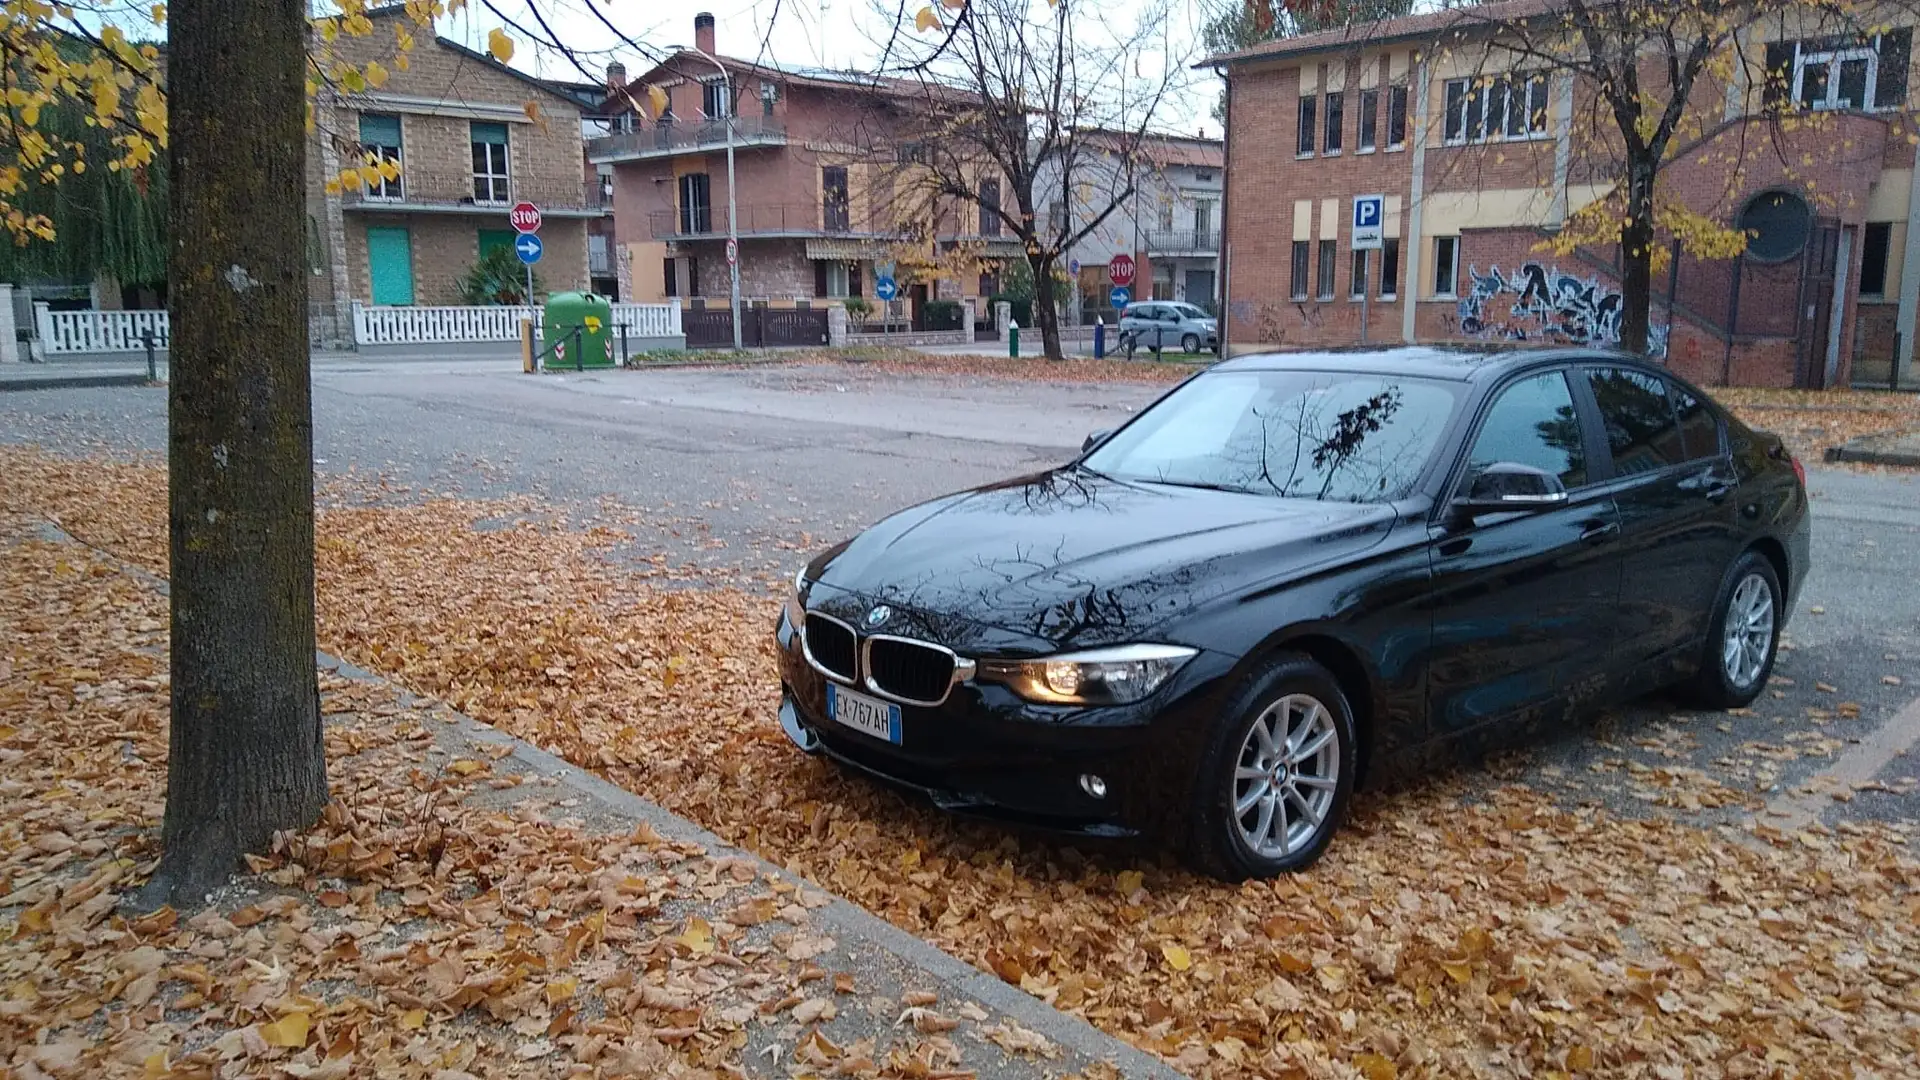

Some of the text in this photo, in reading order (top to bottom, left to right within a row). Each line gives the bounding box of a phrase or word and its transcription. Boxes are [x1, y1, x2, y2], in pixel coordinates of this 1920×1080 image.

[512, 210, 538, 224] STOP
[1360, 202, 1375, 225] P
[1110, 262, 1133, 277] STOP
